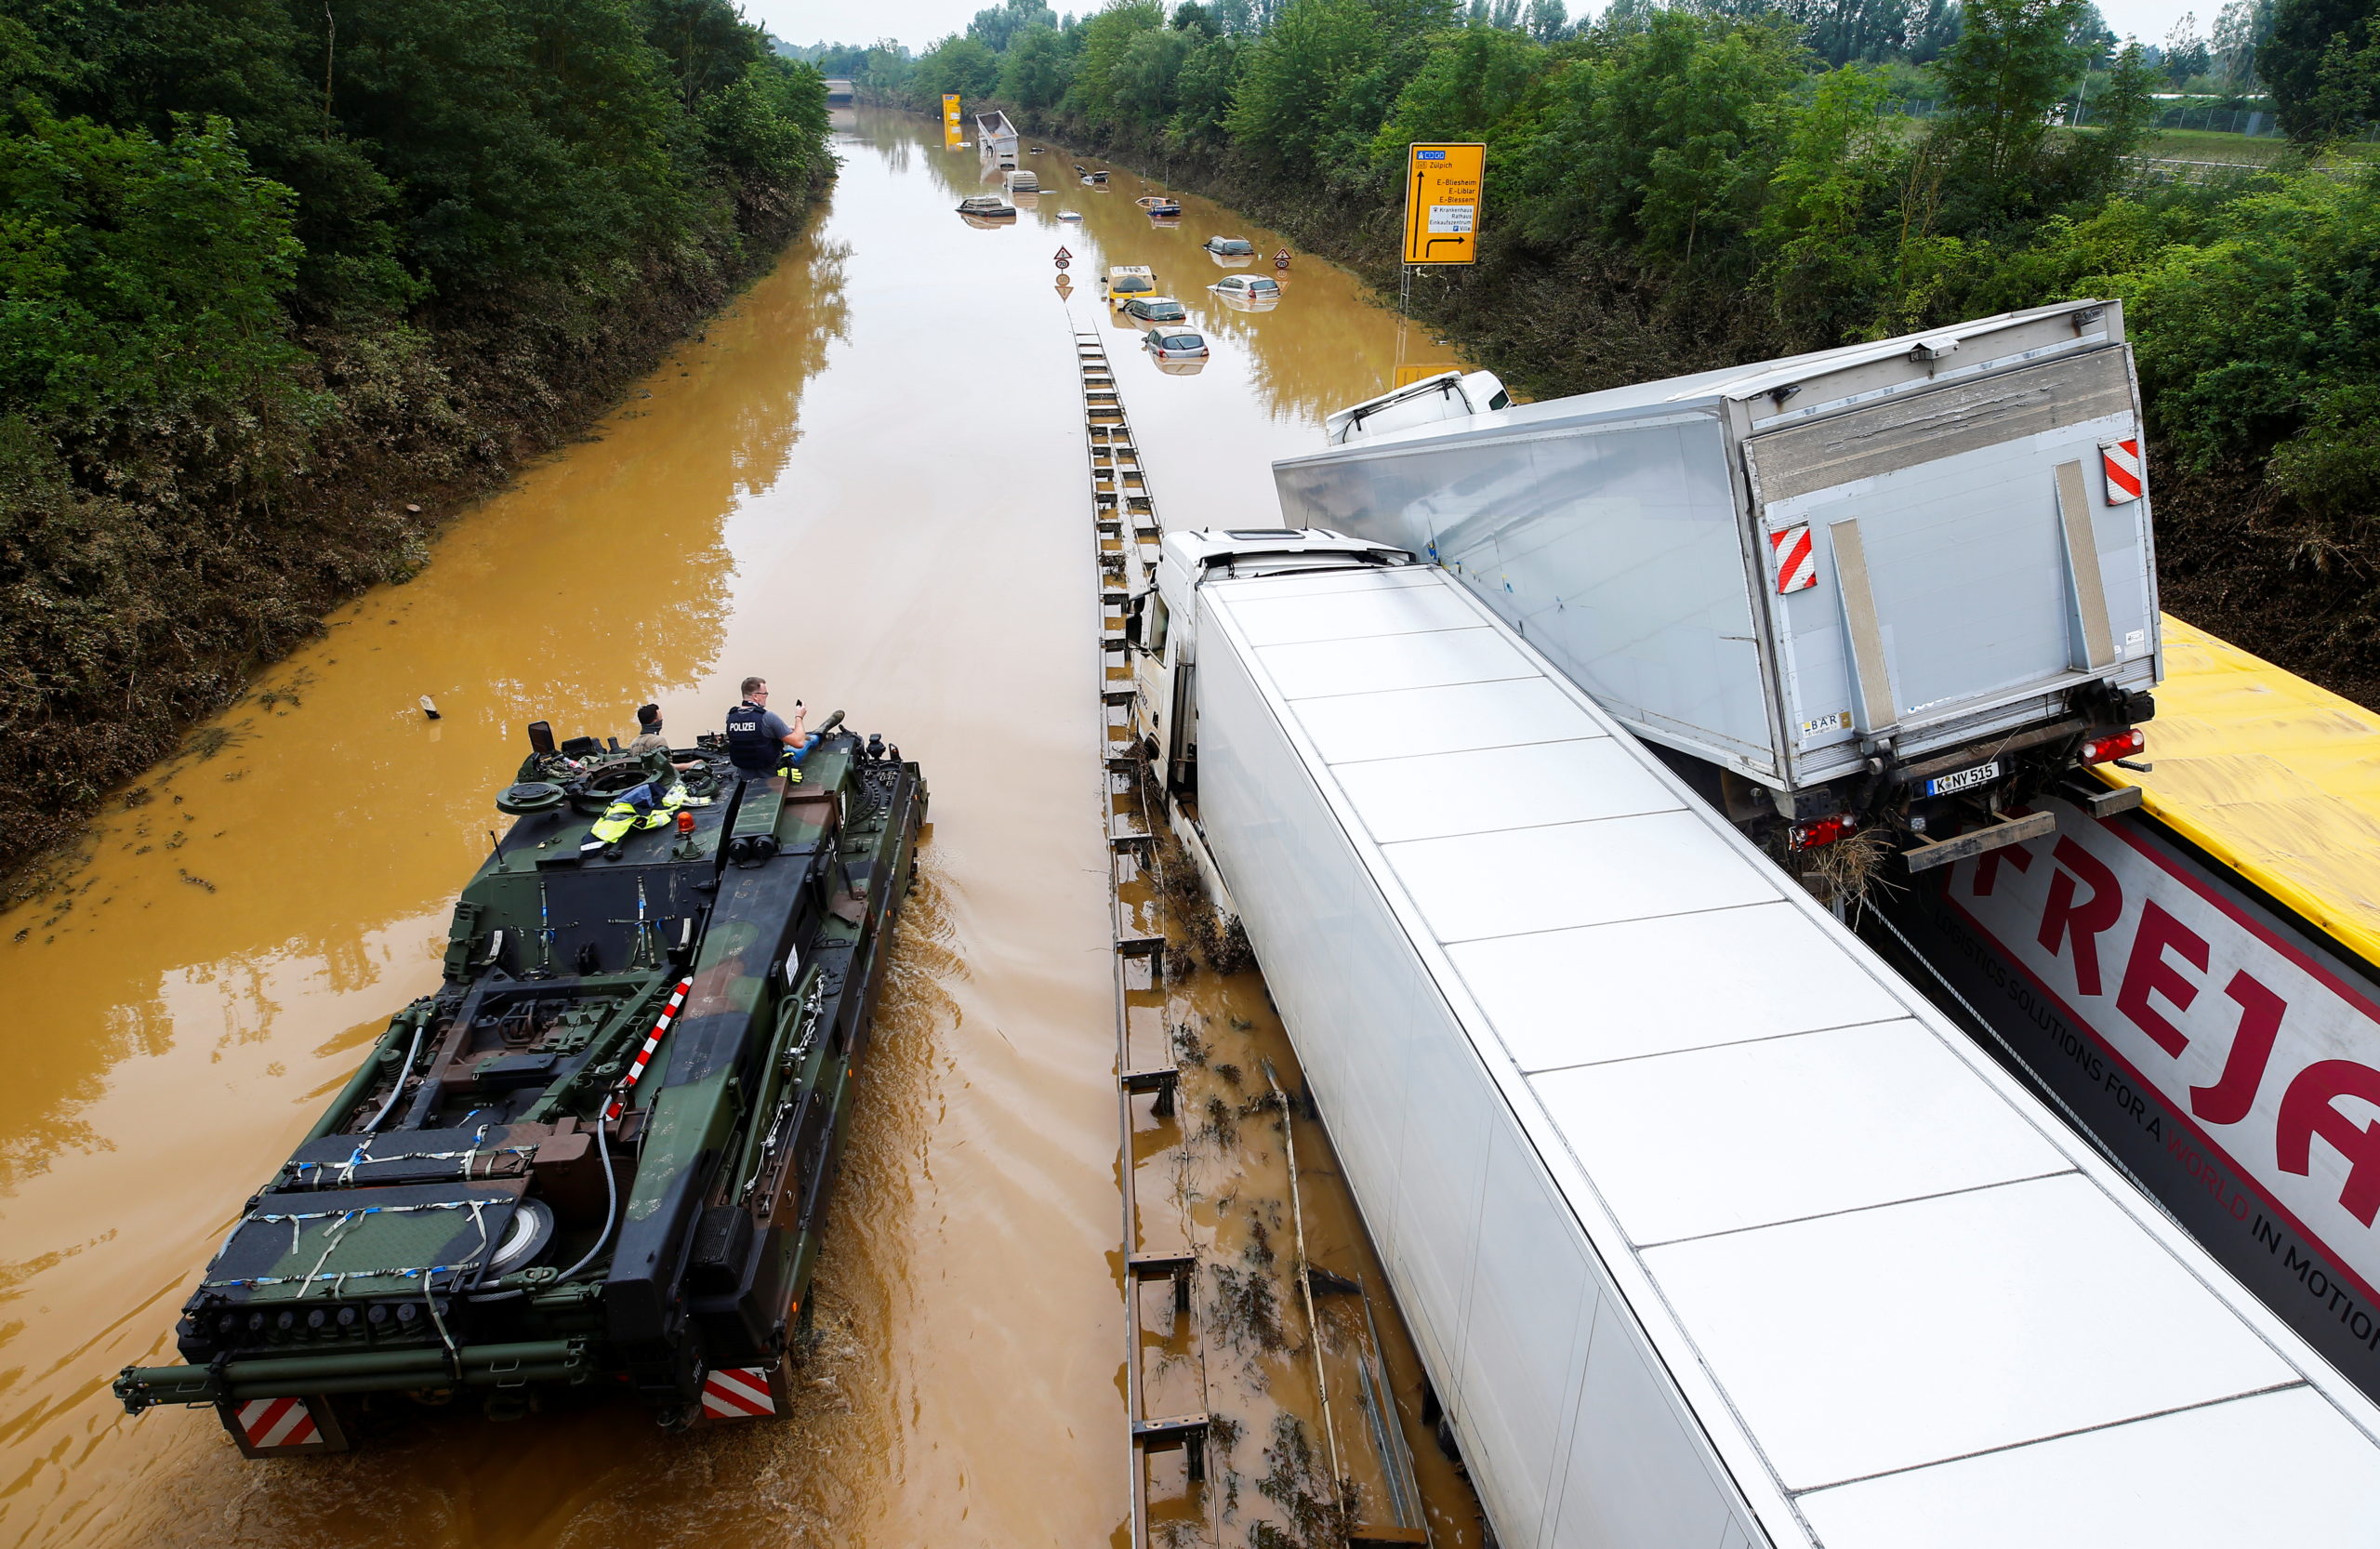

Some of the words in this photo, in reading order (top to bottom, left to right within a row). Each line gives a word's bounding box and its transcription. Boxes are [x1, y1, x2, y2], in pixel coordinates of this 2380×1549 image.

[729, 722, 756, 732] POLIZEI
[1937, 779, 1945, 791] K
[1952, 772, 1968, 788] NY
[1970, 765, 1992, 782] 515
[1933, 907, 2006, 988] LOGISTICS
[2007, 980, 2103, 1081] SOLUTIONS
[2104, 1072, 2146, 1124] FOR
[2146, 1117, 2161, 1143] A
[2167, 1129, 2250, 1222] WORLD
[2251, 1214, 2281, 1255] IN
